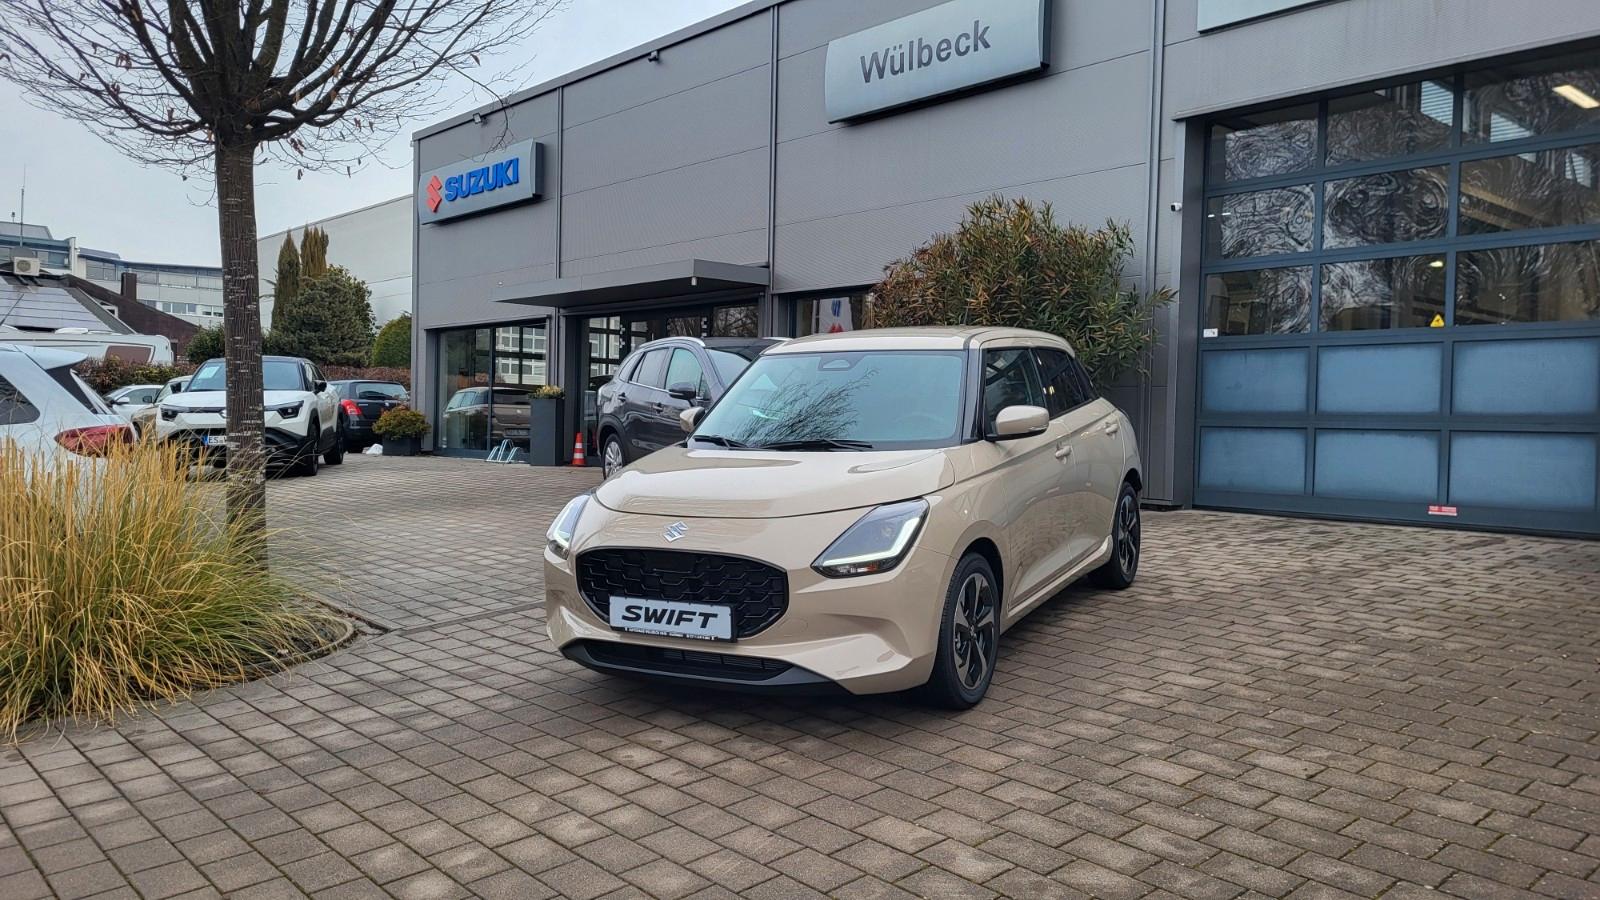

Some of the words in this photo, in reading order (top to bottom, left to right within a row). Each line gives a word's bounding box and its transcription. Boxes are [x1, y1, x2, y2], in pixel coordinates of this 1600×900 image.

[860, 20, 991, 83] Wülbeck
[444, 157, 519, 202] SUZUKI
[621, 605, 718, 629] SWIFT
